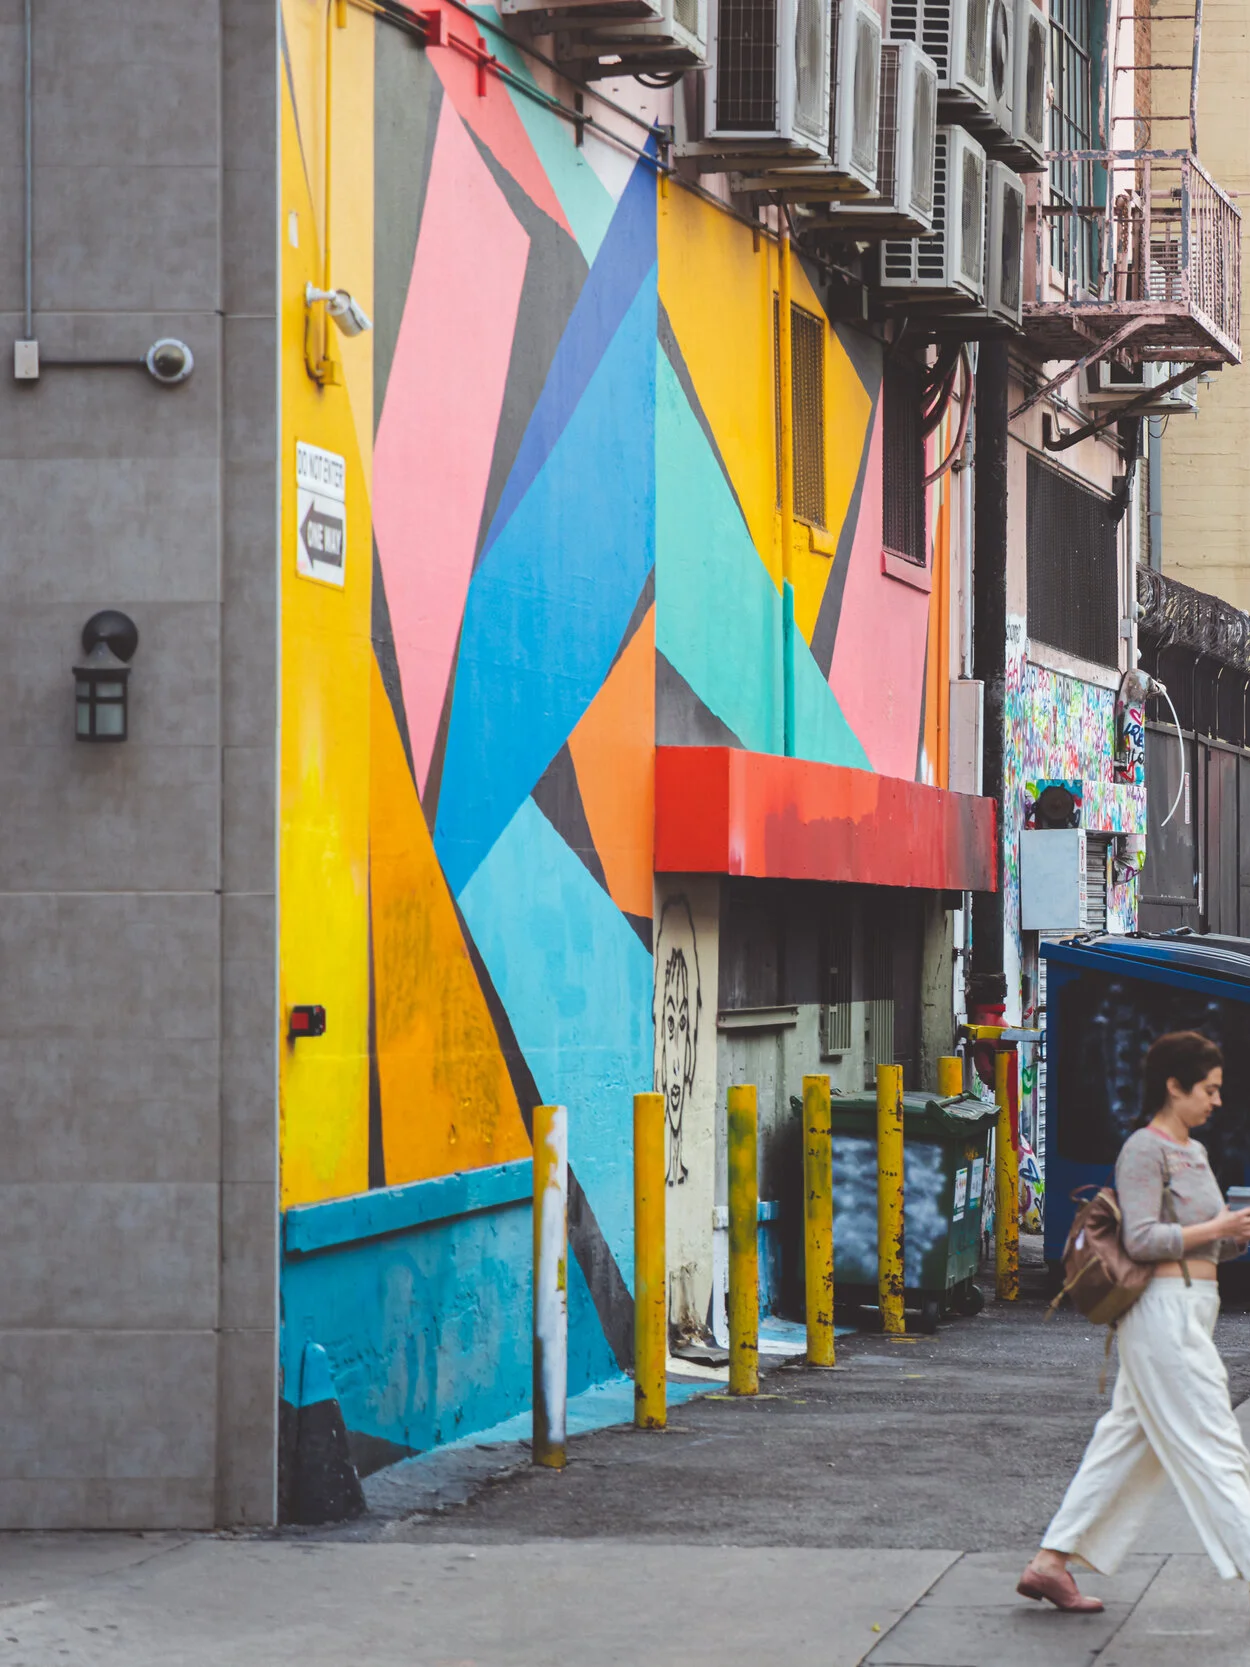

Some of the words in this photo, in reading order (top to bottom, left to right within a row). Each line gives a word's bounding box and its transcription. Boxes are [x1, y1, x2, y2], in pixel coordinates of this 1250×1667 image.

[297, 448, 307, 476] DO
[309, 452, 323, 481] NOT
[323, 457, 344, 490] ENTER
[307, 520, 323, 551] ONE
[324, 525, 342, 556] WAY
